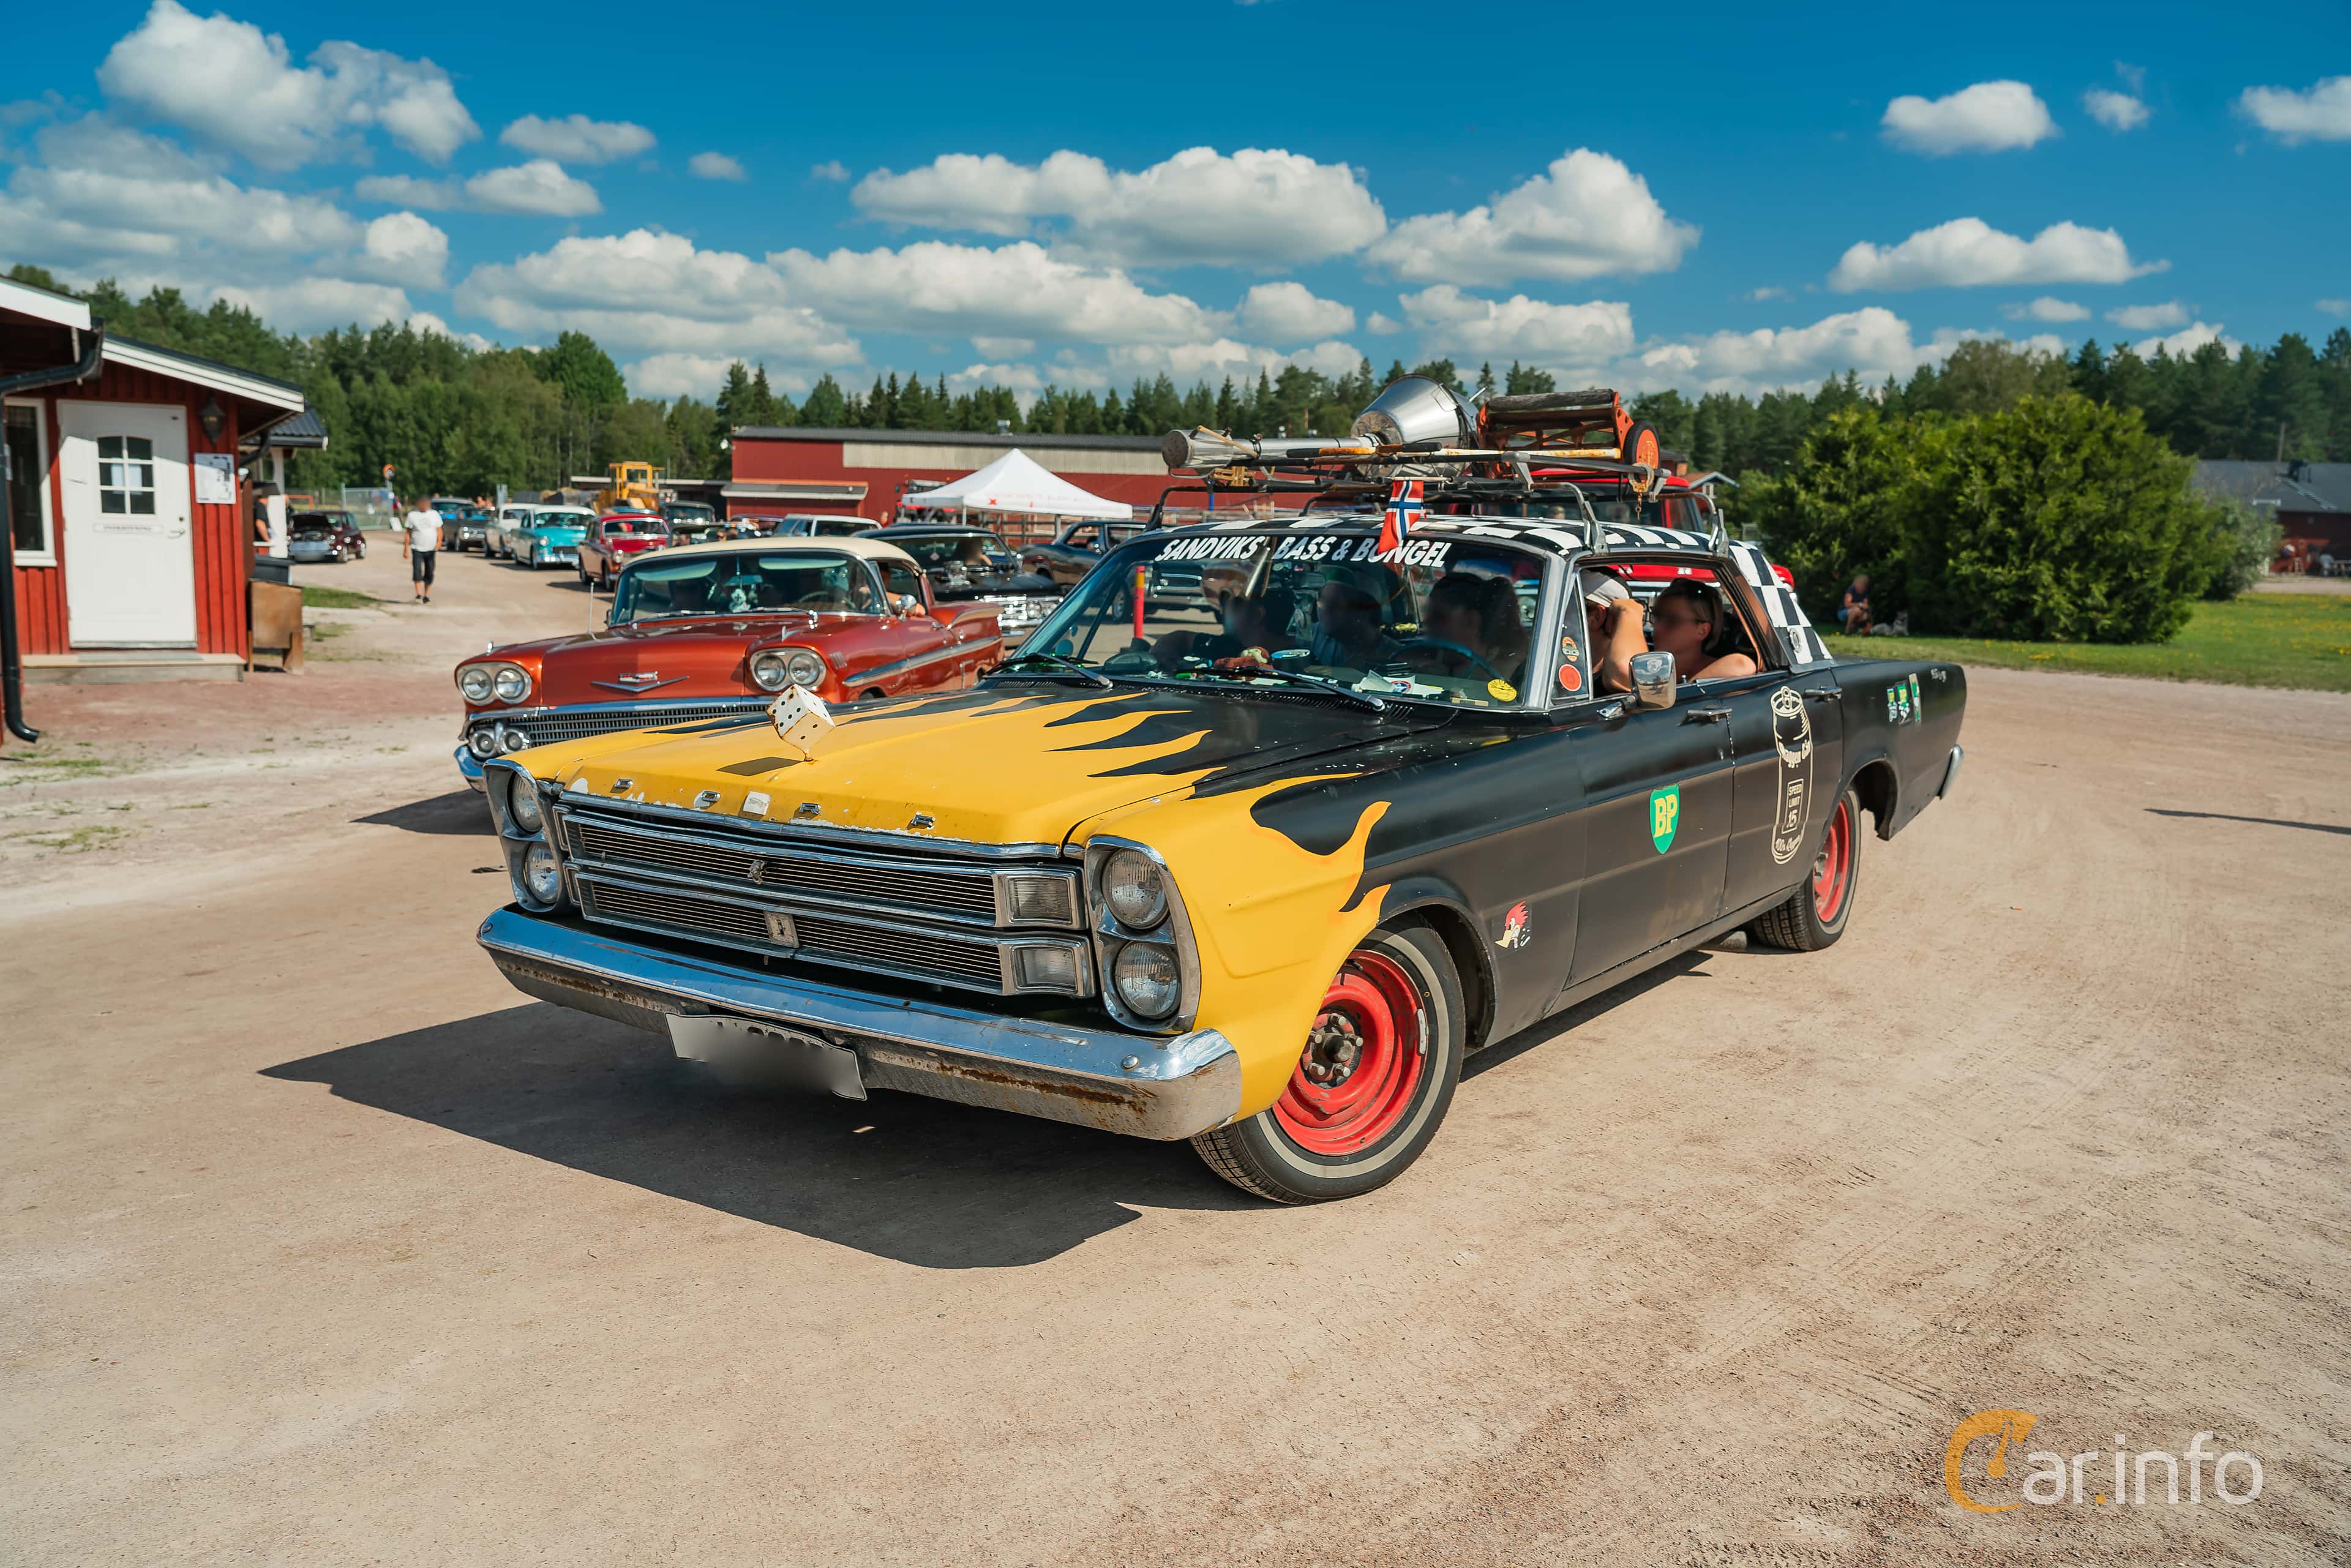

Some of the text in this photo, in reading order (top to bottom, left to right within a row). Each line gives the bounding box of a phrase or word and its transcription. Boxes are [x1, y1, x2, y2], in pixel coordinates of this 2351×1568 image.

[1155, 536, 1266, 561] SANDVIKS
[1271, 536, 1338, 560] BASS
[1331, 539, 1353, 561] &
[1788, 784, 1802, 796] SPEED
[1654, 794, 1678, 838] BP
[1787, 809, 1798, 828] 15
